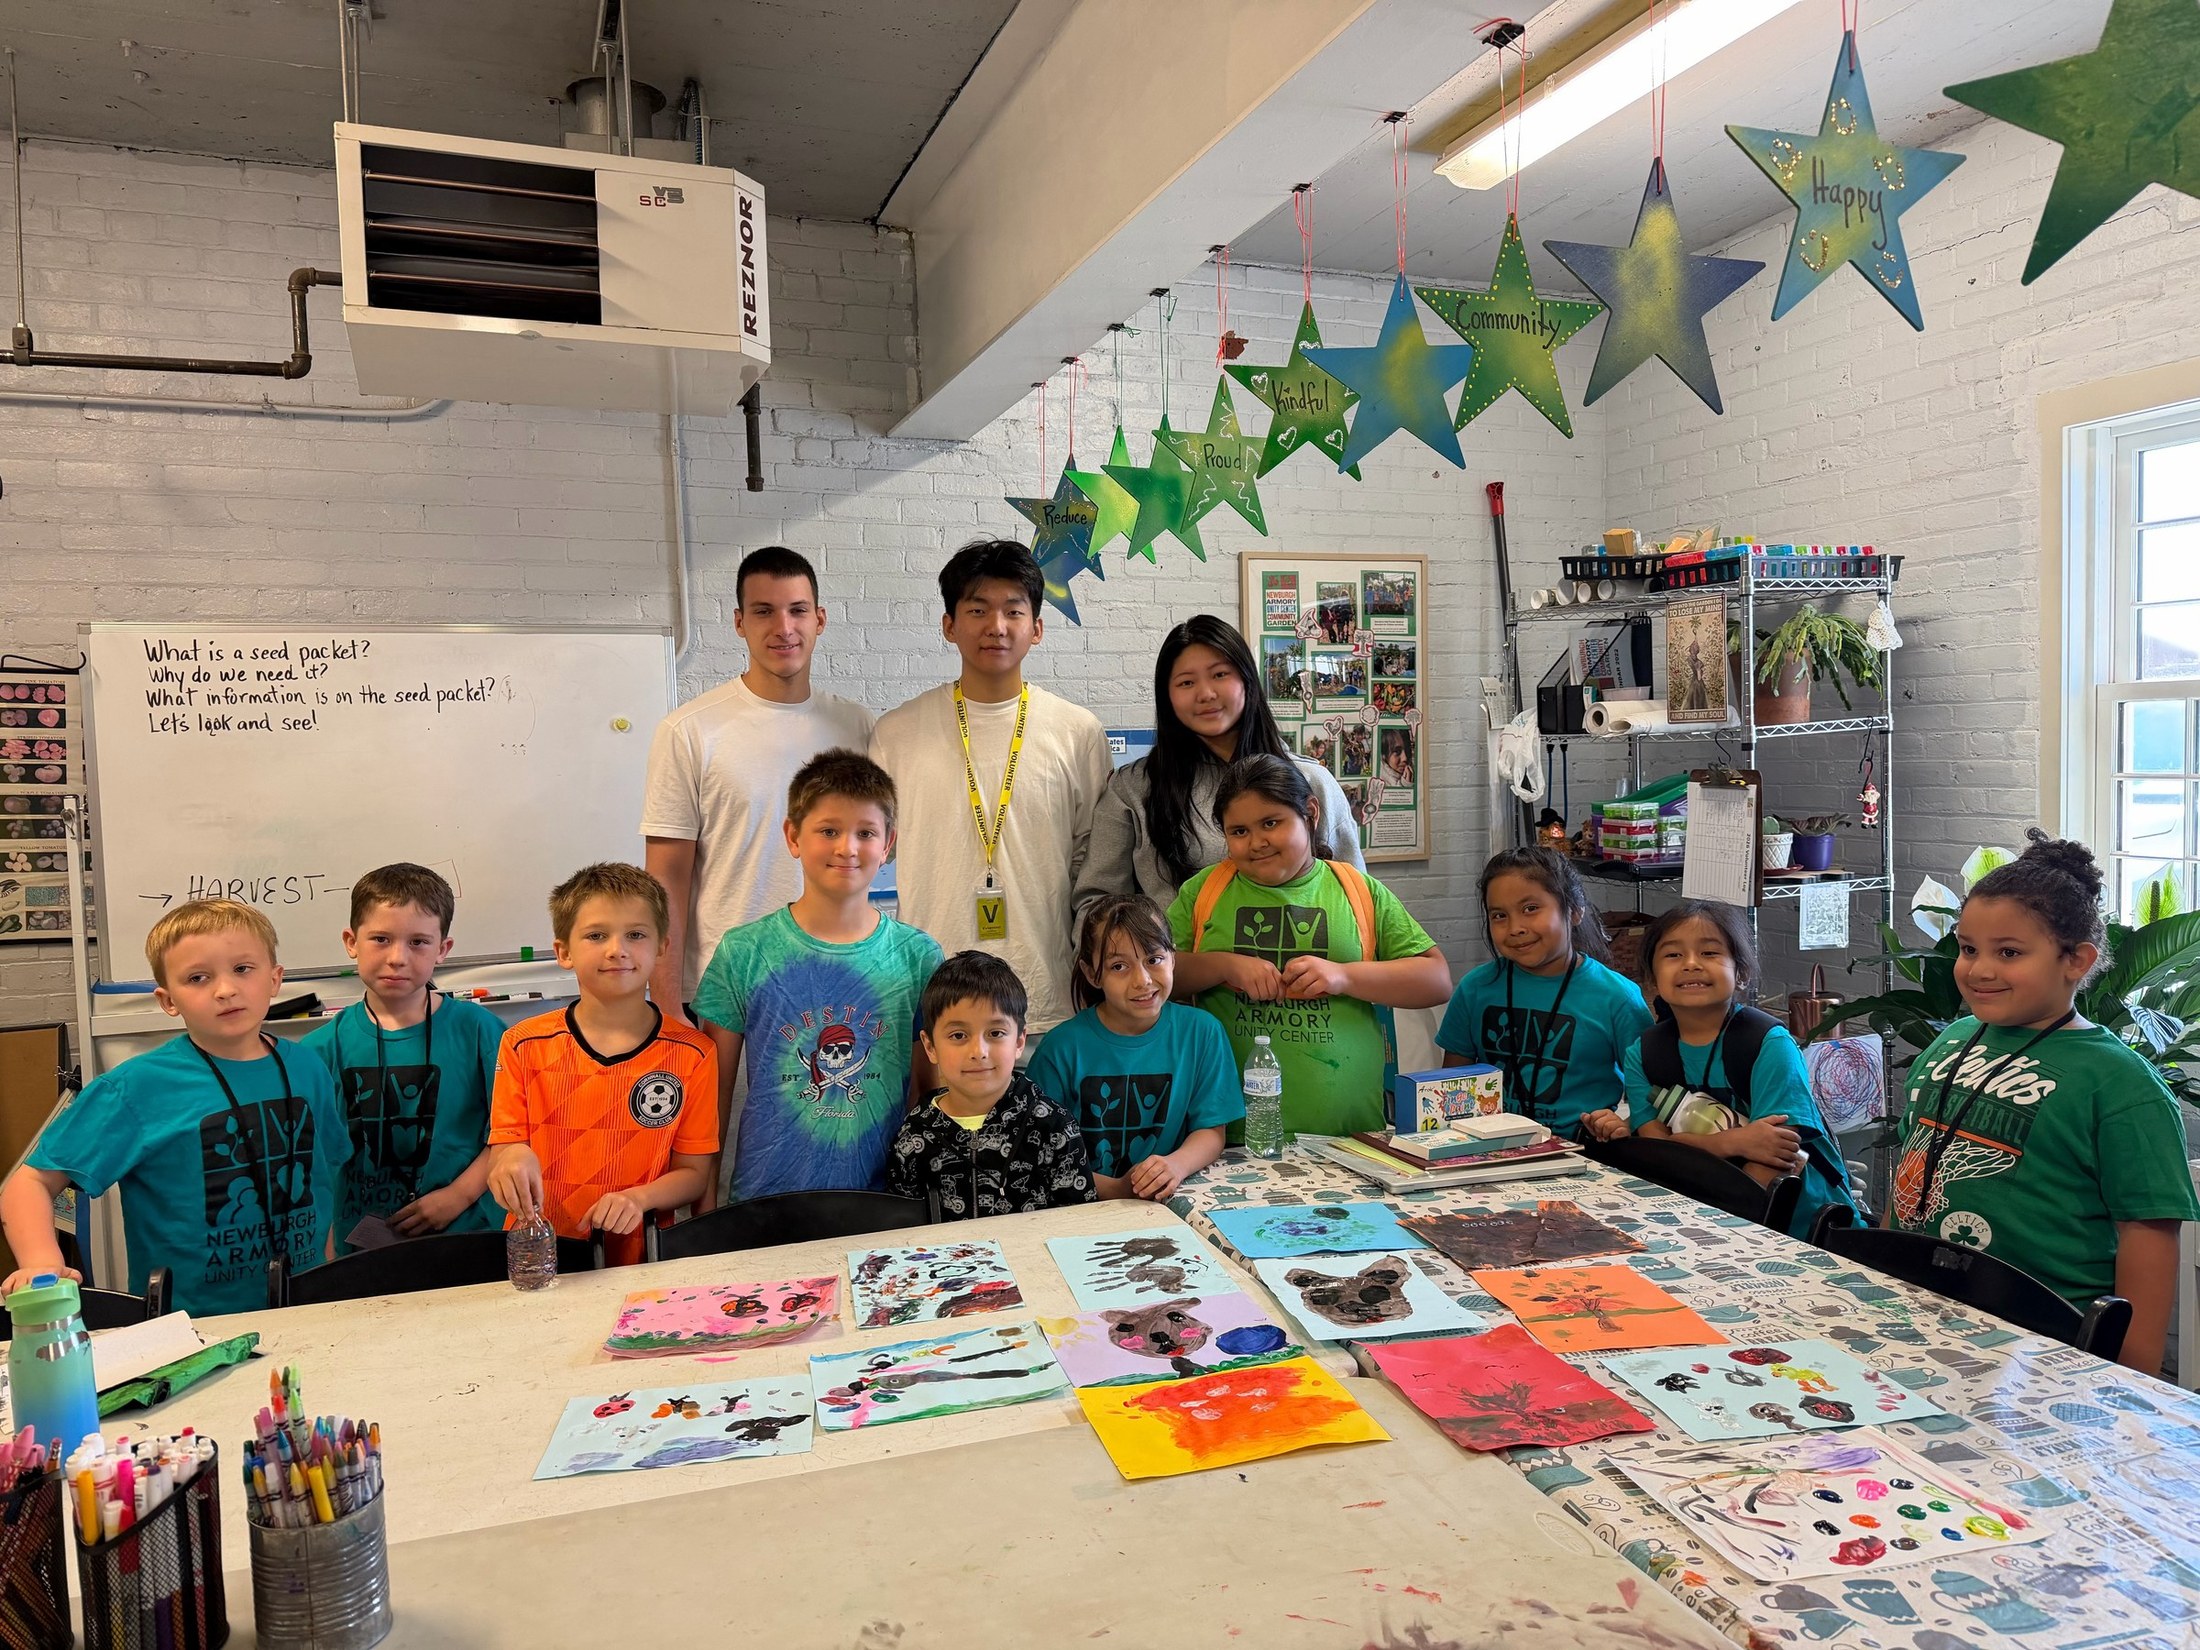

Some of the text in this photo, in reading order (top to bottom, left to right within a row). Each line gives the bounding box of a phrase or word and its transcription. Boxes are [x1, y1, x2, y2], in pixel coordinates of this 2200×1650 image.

[1812, 156, 1888, 250] Happy
[740, 195, 757, 337] REZNOR
[1456, 300, 1561, 349] Community
[1271, 379, 1329, 416] Kindful
[1203, 444, 1241, 471] Proud
[1043, 505, 1088, 529] Reduce
[1267, 591, 1296, 599] NEWBURGH
[1679, 608, 1692, 616] LOSE
[1693, 606, 1704, 614] MY
[1705, 604, 1722, 612] MIND
[144, 639, 370, 667] What is a seed packet?
[148, 663, 329, 692] Why do we need it?
[146, 677, 495, 713] What information is on the seed packet?
[149, 709, 320, 736] Let's look and see!
[956, 700, 968, 738] VOLUNTEER
[1016, 701, 1027, 738] VOLUNTEER
[1699, 711, 1708, 719] MY
[966, 757, 976, 792] VOLUNT
[1004, 751, 1018, 791] VOLUNTEER
[992, 804, 1007, 845] VOLUNTEER
[187, 875, 325, 904] HARVEST
[982, 904, 998, 923] V
[779, 1004, 890, 1042] DESTIN
[1236, 1009, 1331, 1029] ARMORY
[1235, 1025, 1335, 1043] UNITY CENTER
[638, 1074, 681, 1088] CORNWALL UNITED
[863, 1073, 881, 1081] 1984
[1931, 1045, 2057, 1105] Celtics
[638, 1116, 673, 1126] SOCCER CLUB
[811, 1105, 857, 1119] Florida
[1422, 1117, 1438, 1131] 12
[207, 1209, 317, 1247] NEWBURGH
[1944, 1214, 1989, 1234] CELTICS
[206, 1228, 317, 1268] ARMORY
[205, 1265, 257, 1284] UNITY
